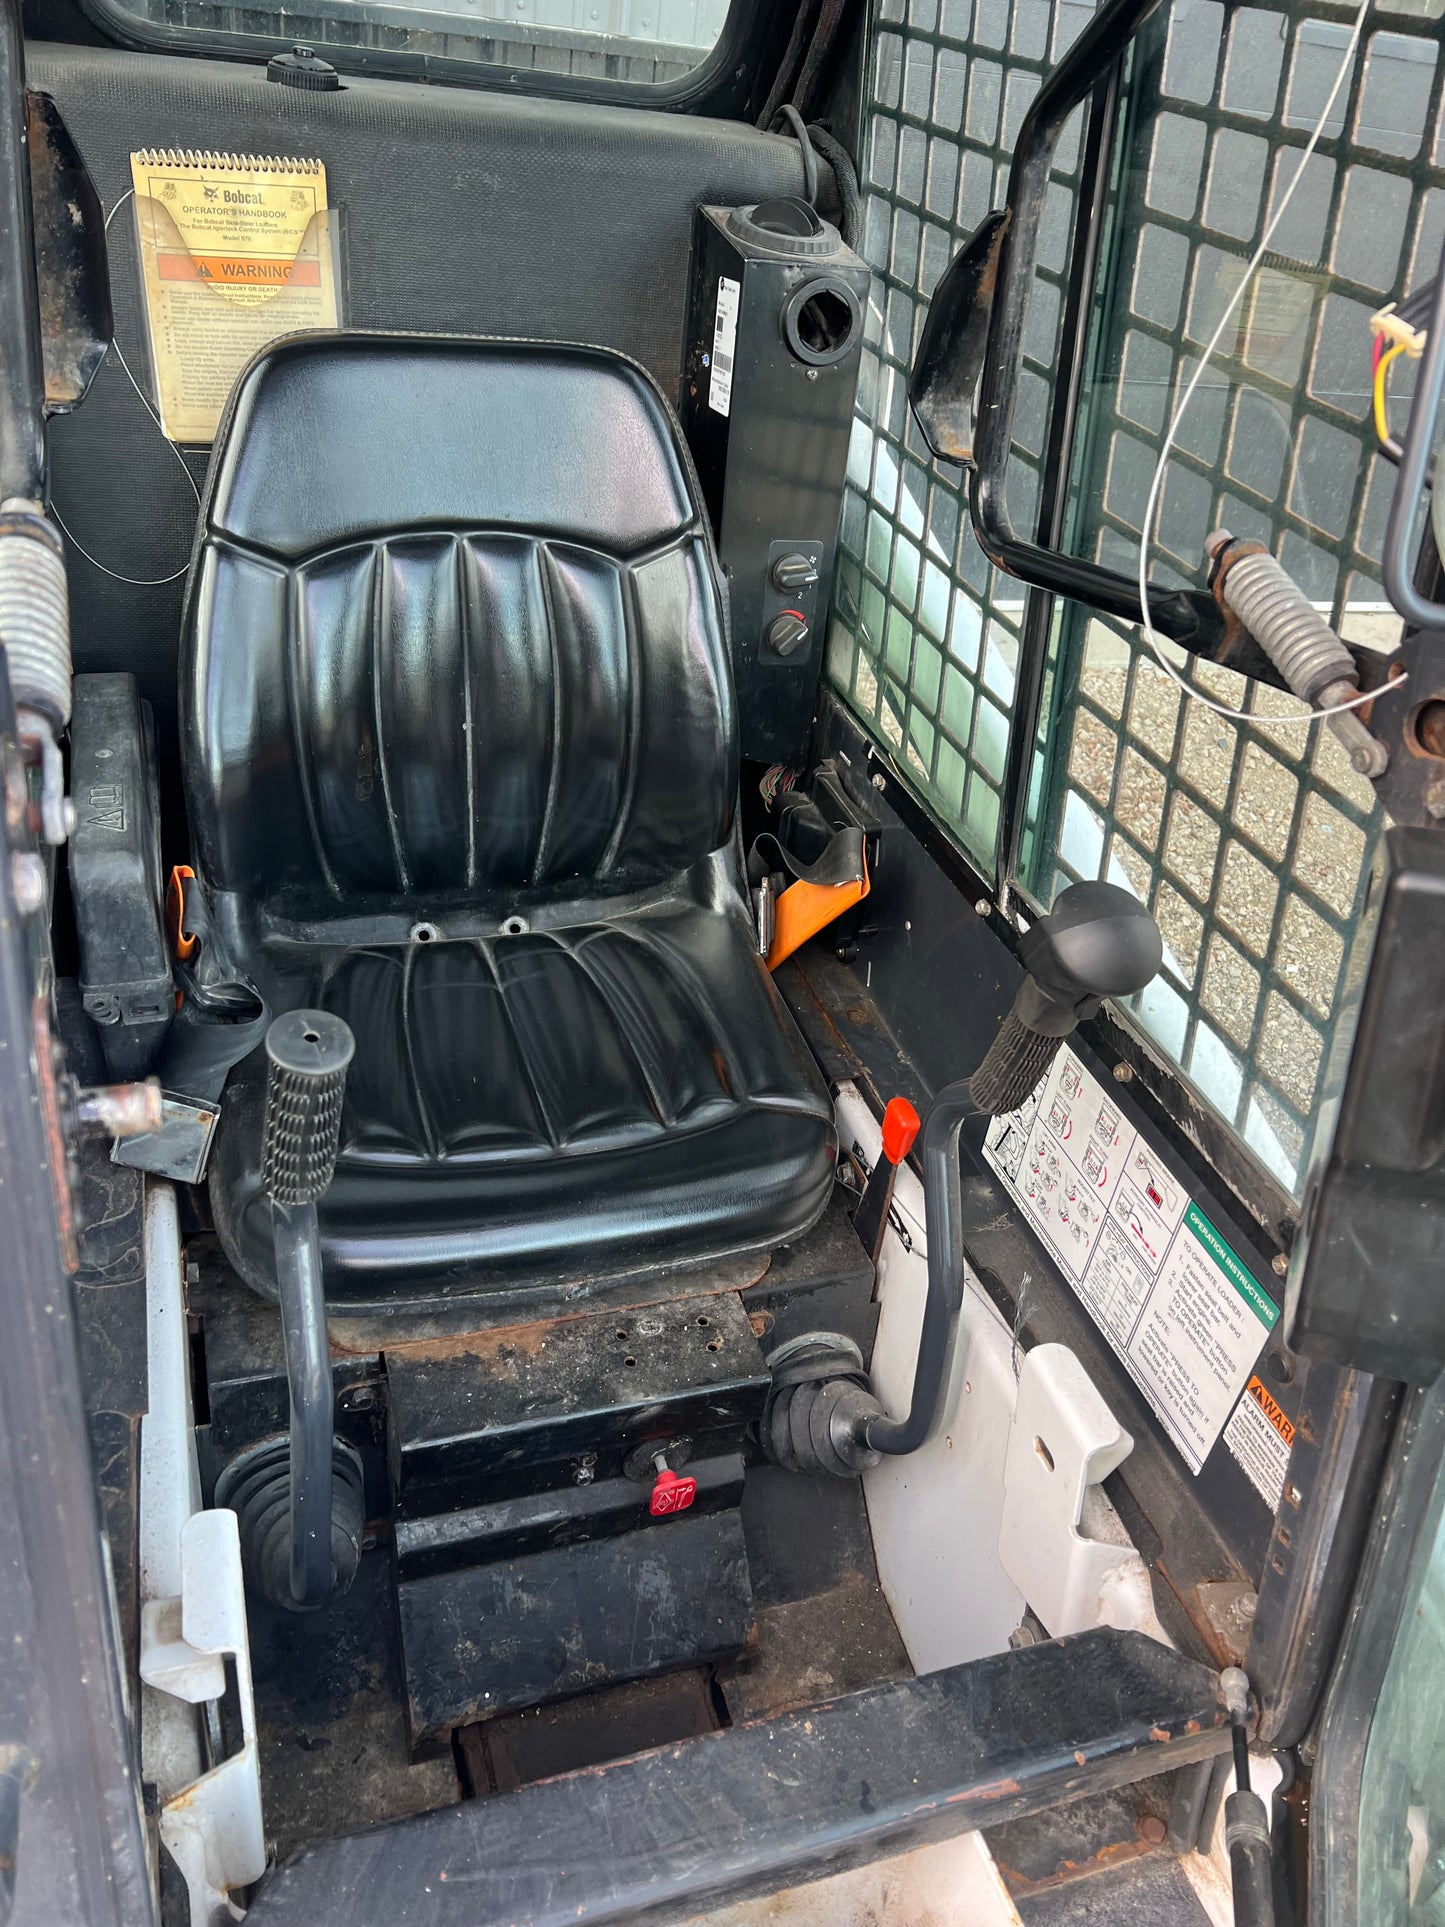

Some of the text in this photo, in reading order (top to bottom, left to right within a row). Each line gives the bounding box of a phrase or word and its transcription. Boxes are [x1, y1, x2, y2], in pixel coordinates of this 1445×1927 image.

[182, 206, 287, 218] OPERATOR'S HANDBOOK
[224, 189, 264, 205] Bobcat
[221, 263, 295, 279] WARNING
[797, 591, 803, 599] 2
[992, 1163, 1003, 1177] See
[1000, 1175, 1021, 1204] Operation
[1020, 1204, 1030, 1218] and
[1028, 1216, 1057, 1257] Maintenance
[1055, 1256, 1073, 1282] Manual
[1072, 1281, 1082, 1295] and
[1081, 1295, 1106, 1332] Handbook
[1105, 1330, 1114, 1343] for
[1112, 1342, 1126, 1363] more
[1178, 1278, 1192, 1300] Start
[1181, 1271, 1197, 1295] lower
[1197, 1292, 1210, 1312] seat
[1182, 1238, 1192, 1254] TO
[1190, 1250, 1217, 1288] OPERATE
[1216, 1284, 1242, 1319] LOADER
[1189, 1209, 1275, 1323] OPERATION INSTRUCTIONS
[1174, 1286, 1197, 1320] Activate
[1196, 1317, 1213, 1343] green
[1185, 1262, 1205, 1292] Fasten
[1204, 1288, 1217, 1309] seat
[1216, 1305, 1229, 1324] belt
[1228, 1320, 1241, 1340] and
[1148, 1320, 1169, 1354] Activate
[1189, 1380, 1199, 1397] TO
[1167, 1303, 1176, 1316] on
[1175, 1313, 1185, 1329] left
[1184, 1326, 1213, 1369] instrument
[1171, 1294, 1181, 1310] TO
[1208, 1347, 1228, 1376] button
[1137, 1345, 1158, 1377] lowered
[1157, 1374, 1163, 1385] or
[1163, 1383, 1174, 1401] key
[1173, 1397, 1179, 1408] is
[1178, 1405, 1197, 1434] turned
[1141, 1338, 1194, 1417] seat bar is raised and
[1171, 1368, 1189, 1396] button
[1187, 1393, 1204, 1419] again
[1203, 1415, 1209, 1424] if
[1241, 1397, 1264, 1433] ALARM
[1264, 1428, 1285, 1461] MUST
